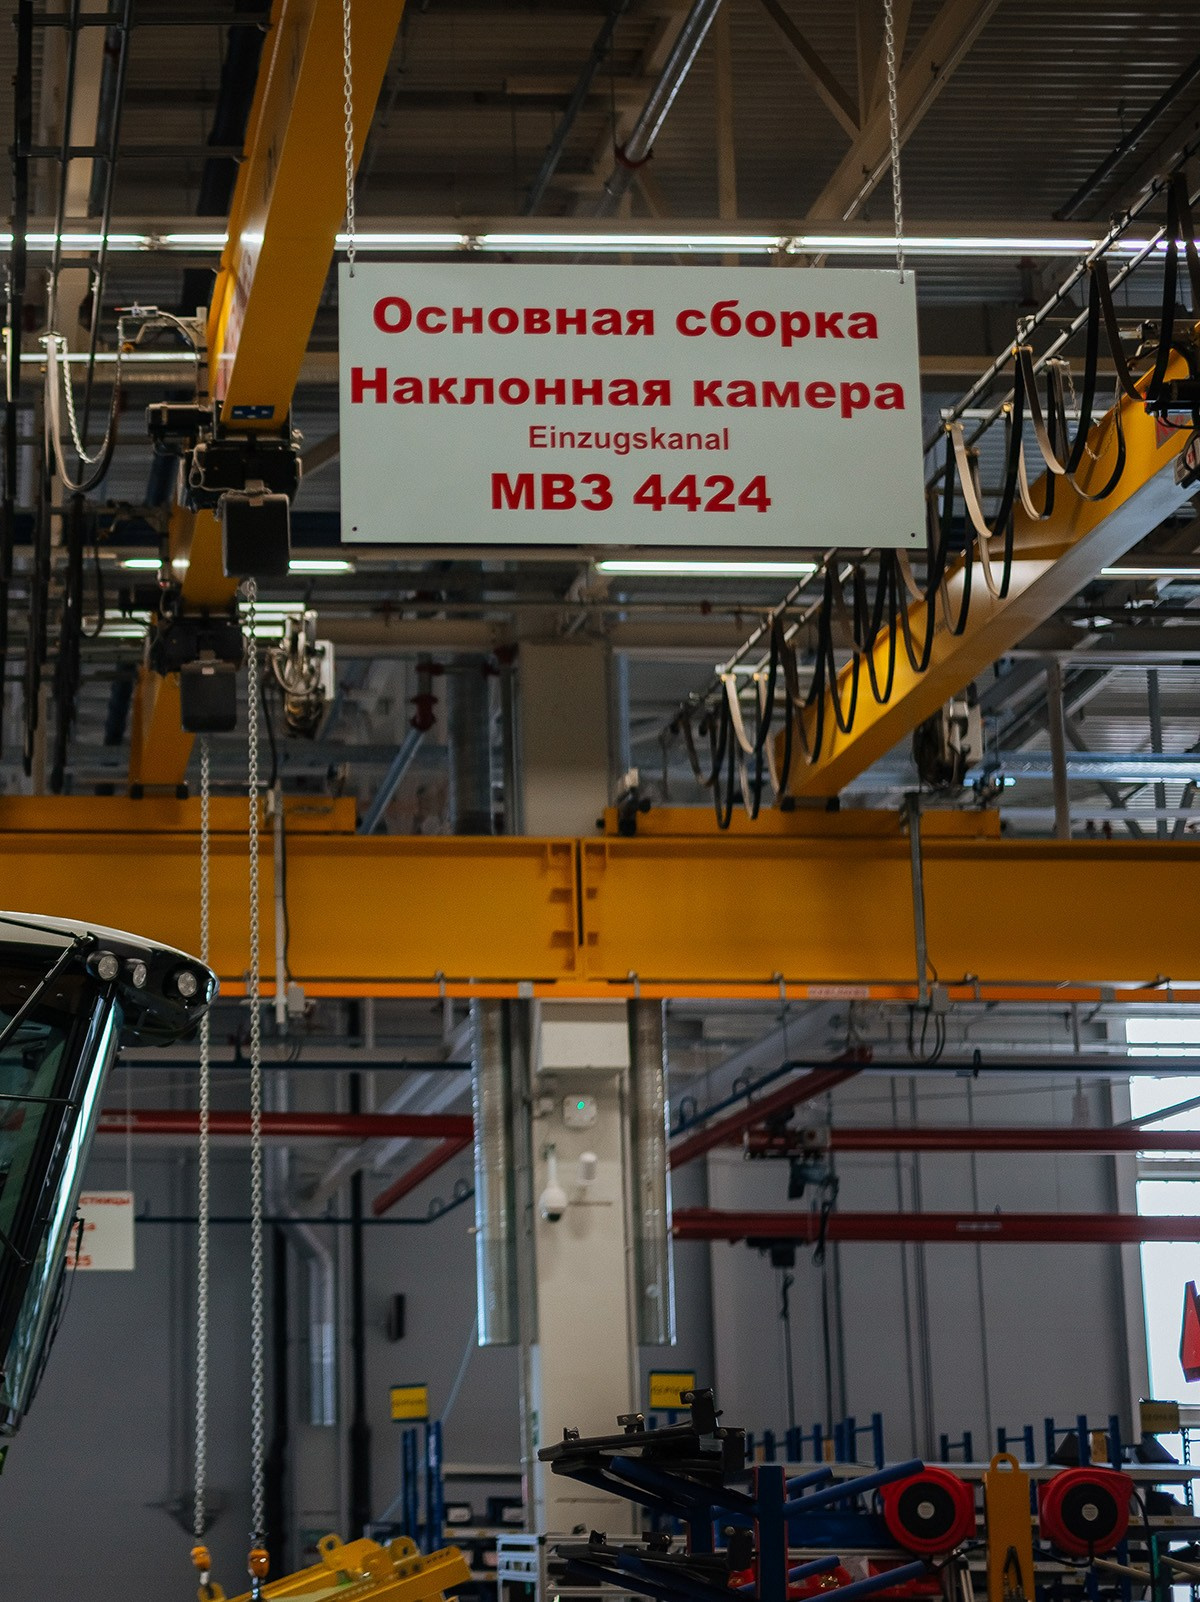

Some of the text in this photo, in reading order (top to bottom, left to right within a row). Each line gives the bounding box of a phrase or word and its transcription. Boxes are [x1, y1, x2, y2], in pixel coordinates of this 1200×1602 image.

[373, 297, 878, 348] Основная сборка
[350, 367, 906, 420] Наклонная камера
[528, 426, 729, 455] Einzugskanal
[490, 472, 772, 513] МВЗ 4424
